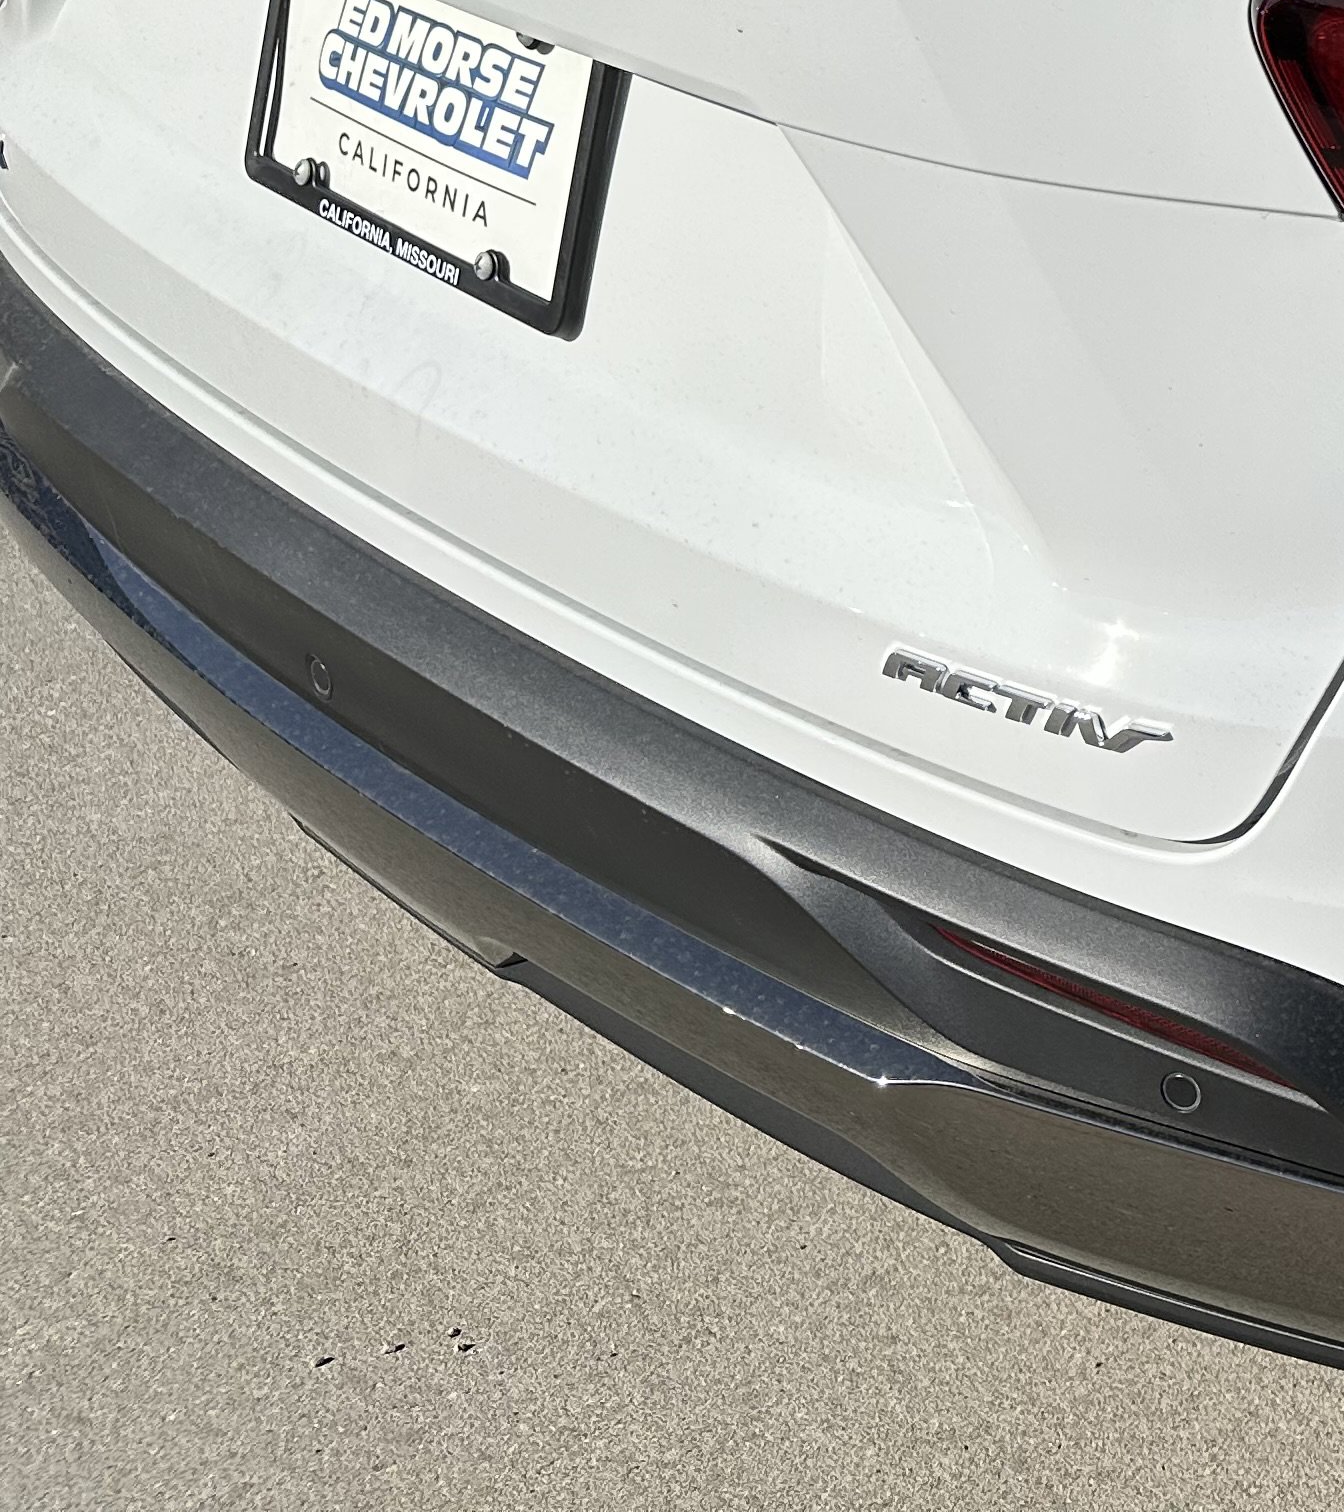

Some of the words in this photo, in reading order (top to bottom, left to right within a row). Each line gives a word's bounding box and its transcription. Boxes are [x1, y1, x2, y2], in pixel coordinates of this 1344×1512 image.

[318, 29, 555, 178] CHEVROLET
[387, 5, 546, 115] MORSE
[338, 132, 489, 227] CALIFORNIA
[318, 198, 394, 255] CALIFORNIA,
[395, 237, 461, 287] MISSOURI
[881, 648, 1174, 754] ACTIV
